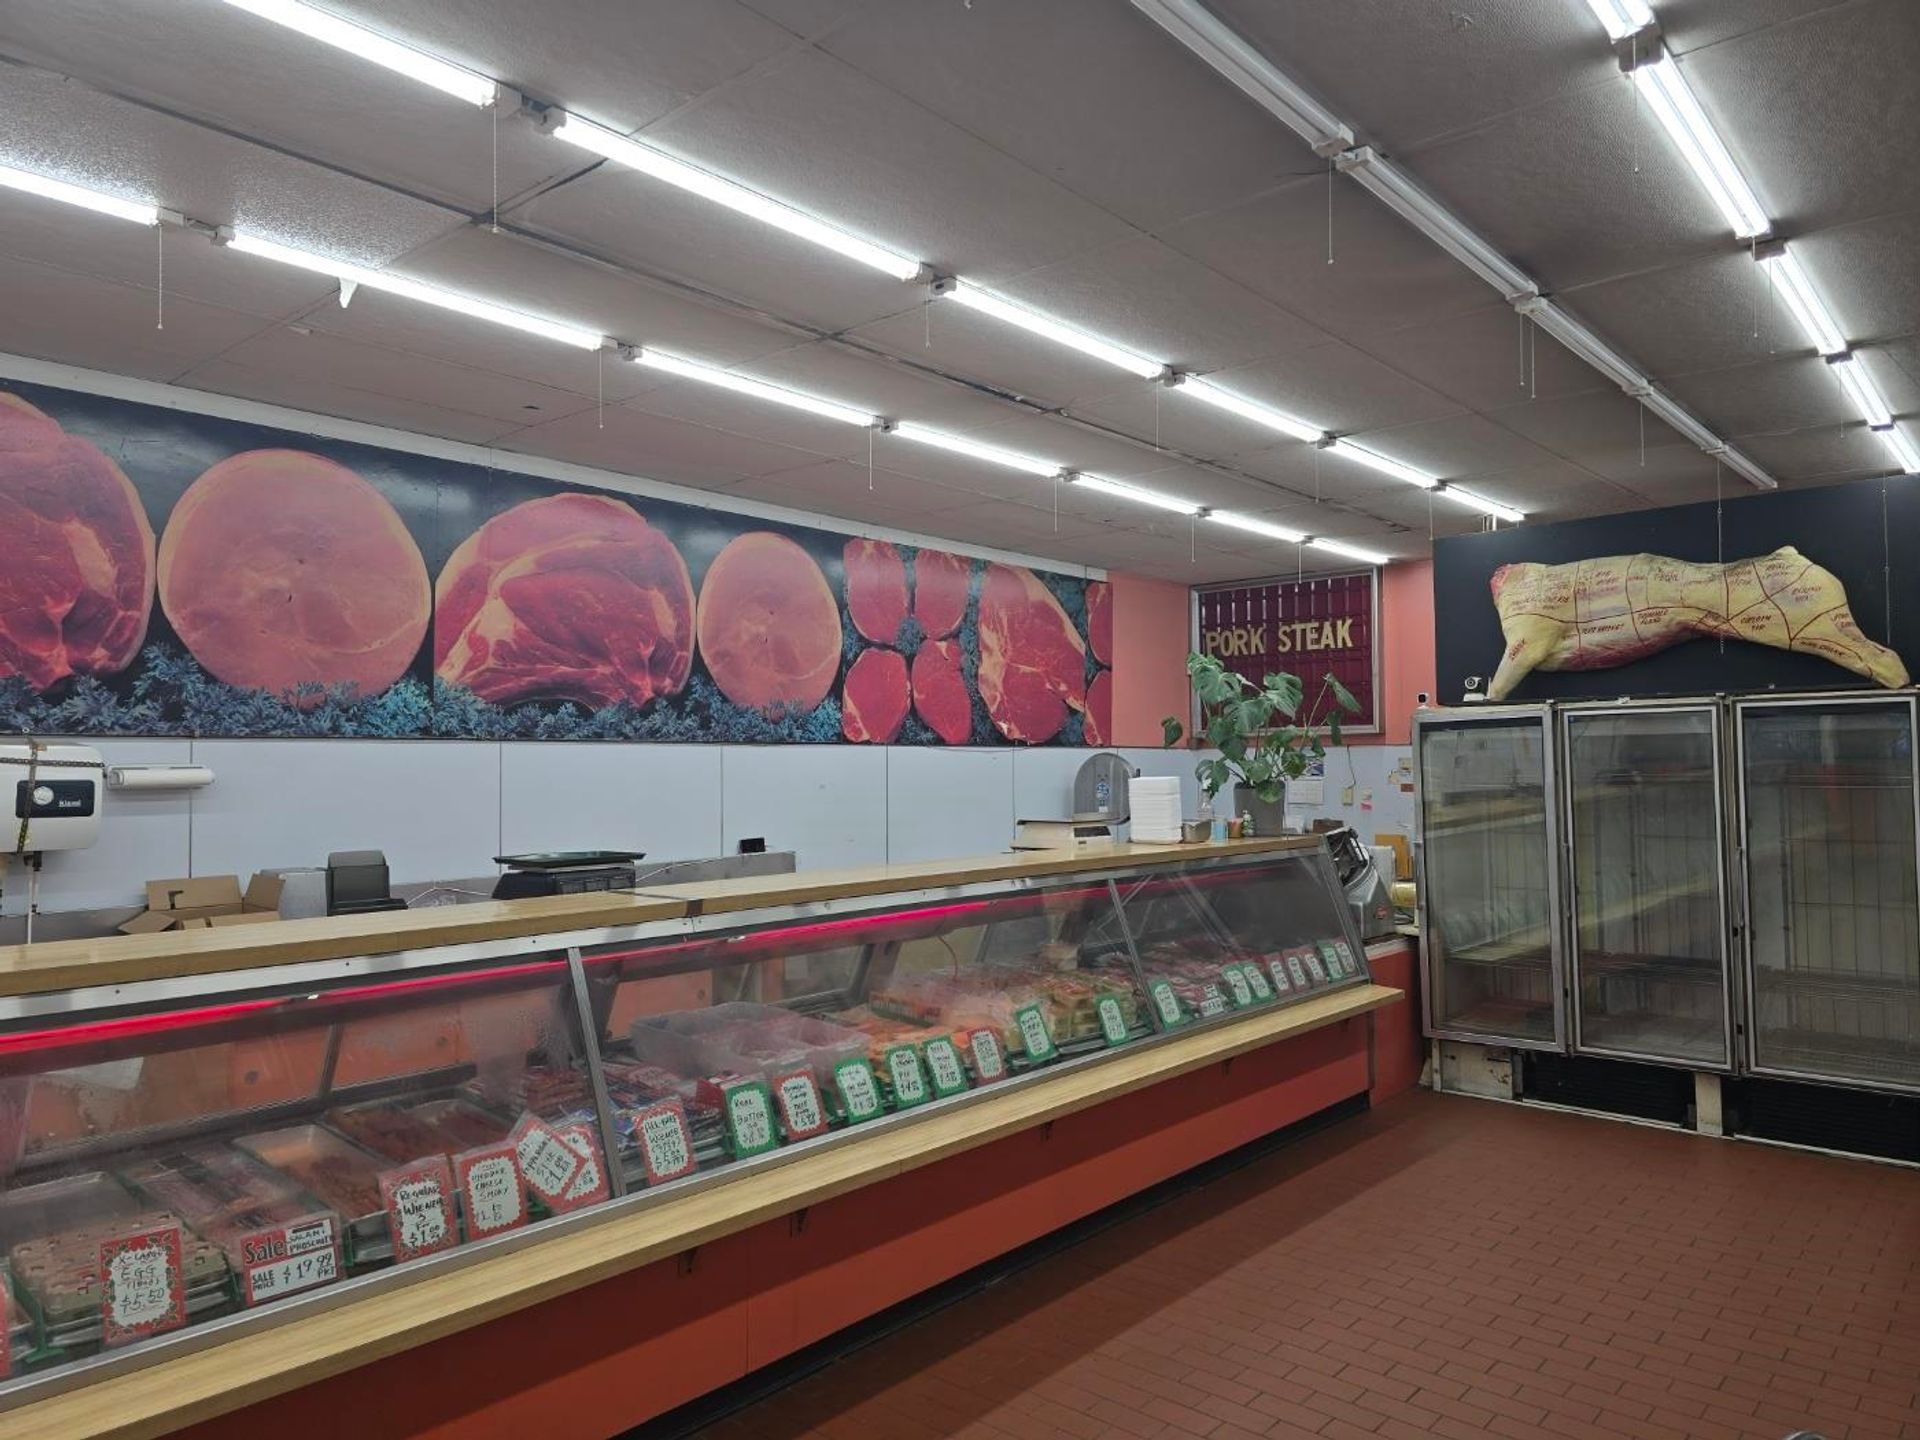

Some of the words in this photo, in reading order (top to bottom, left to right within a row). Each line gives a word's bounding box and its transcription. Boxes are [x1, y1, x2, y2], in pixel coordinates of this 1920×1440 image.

[1206, 627, 1264, 656] PORK
[1278, 619, 1353, 652] STEAK
[245, 1236, 285, 1264] Sale
[121, 1264, 155, 1280] EGG
[252, 1269, 274, 1282] SALE
